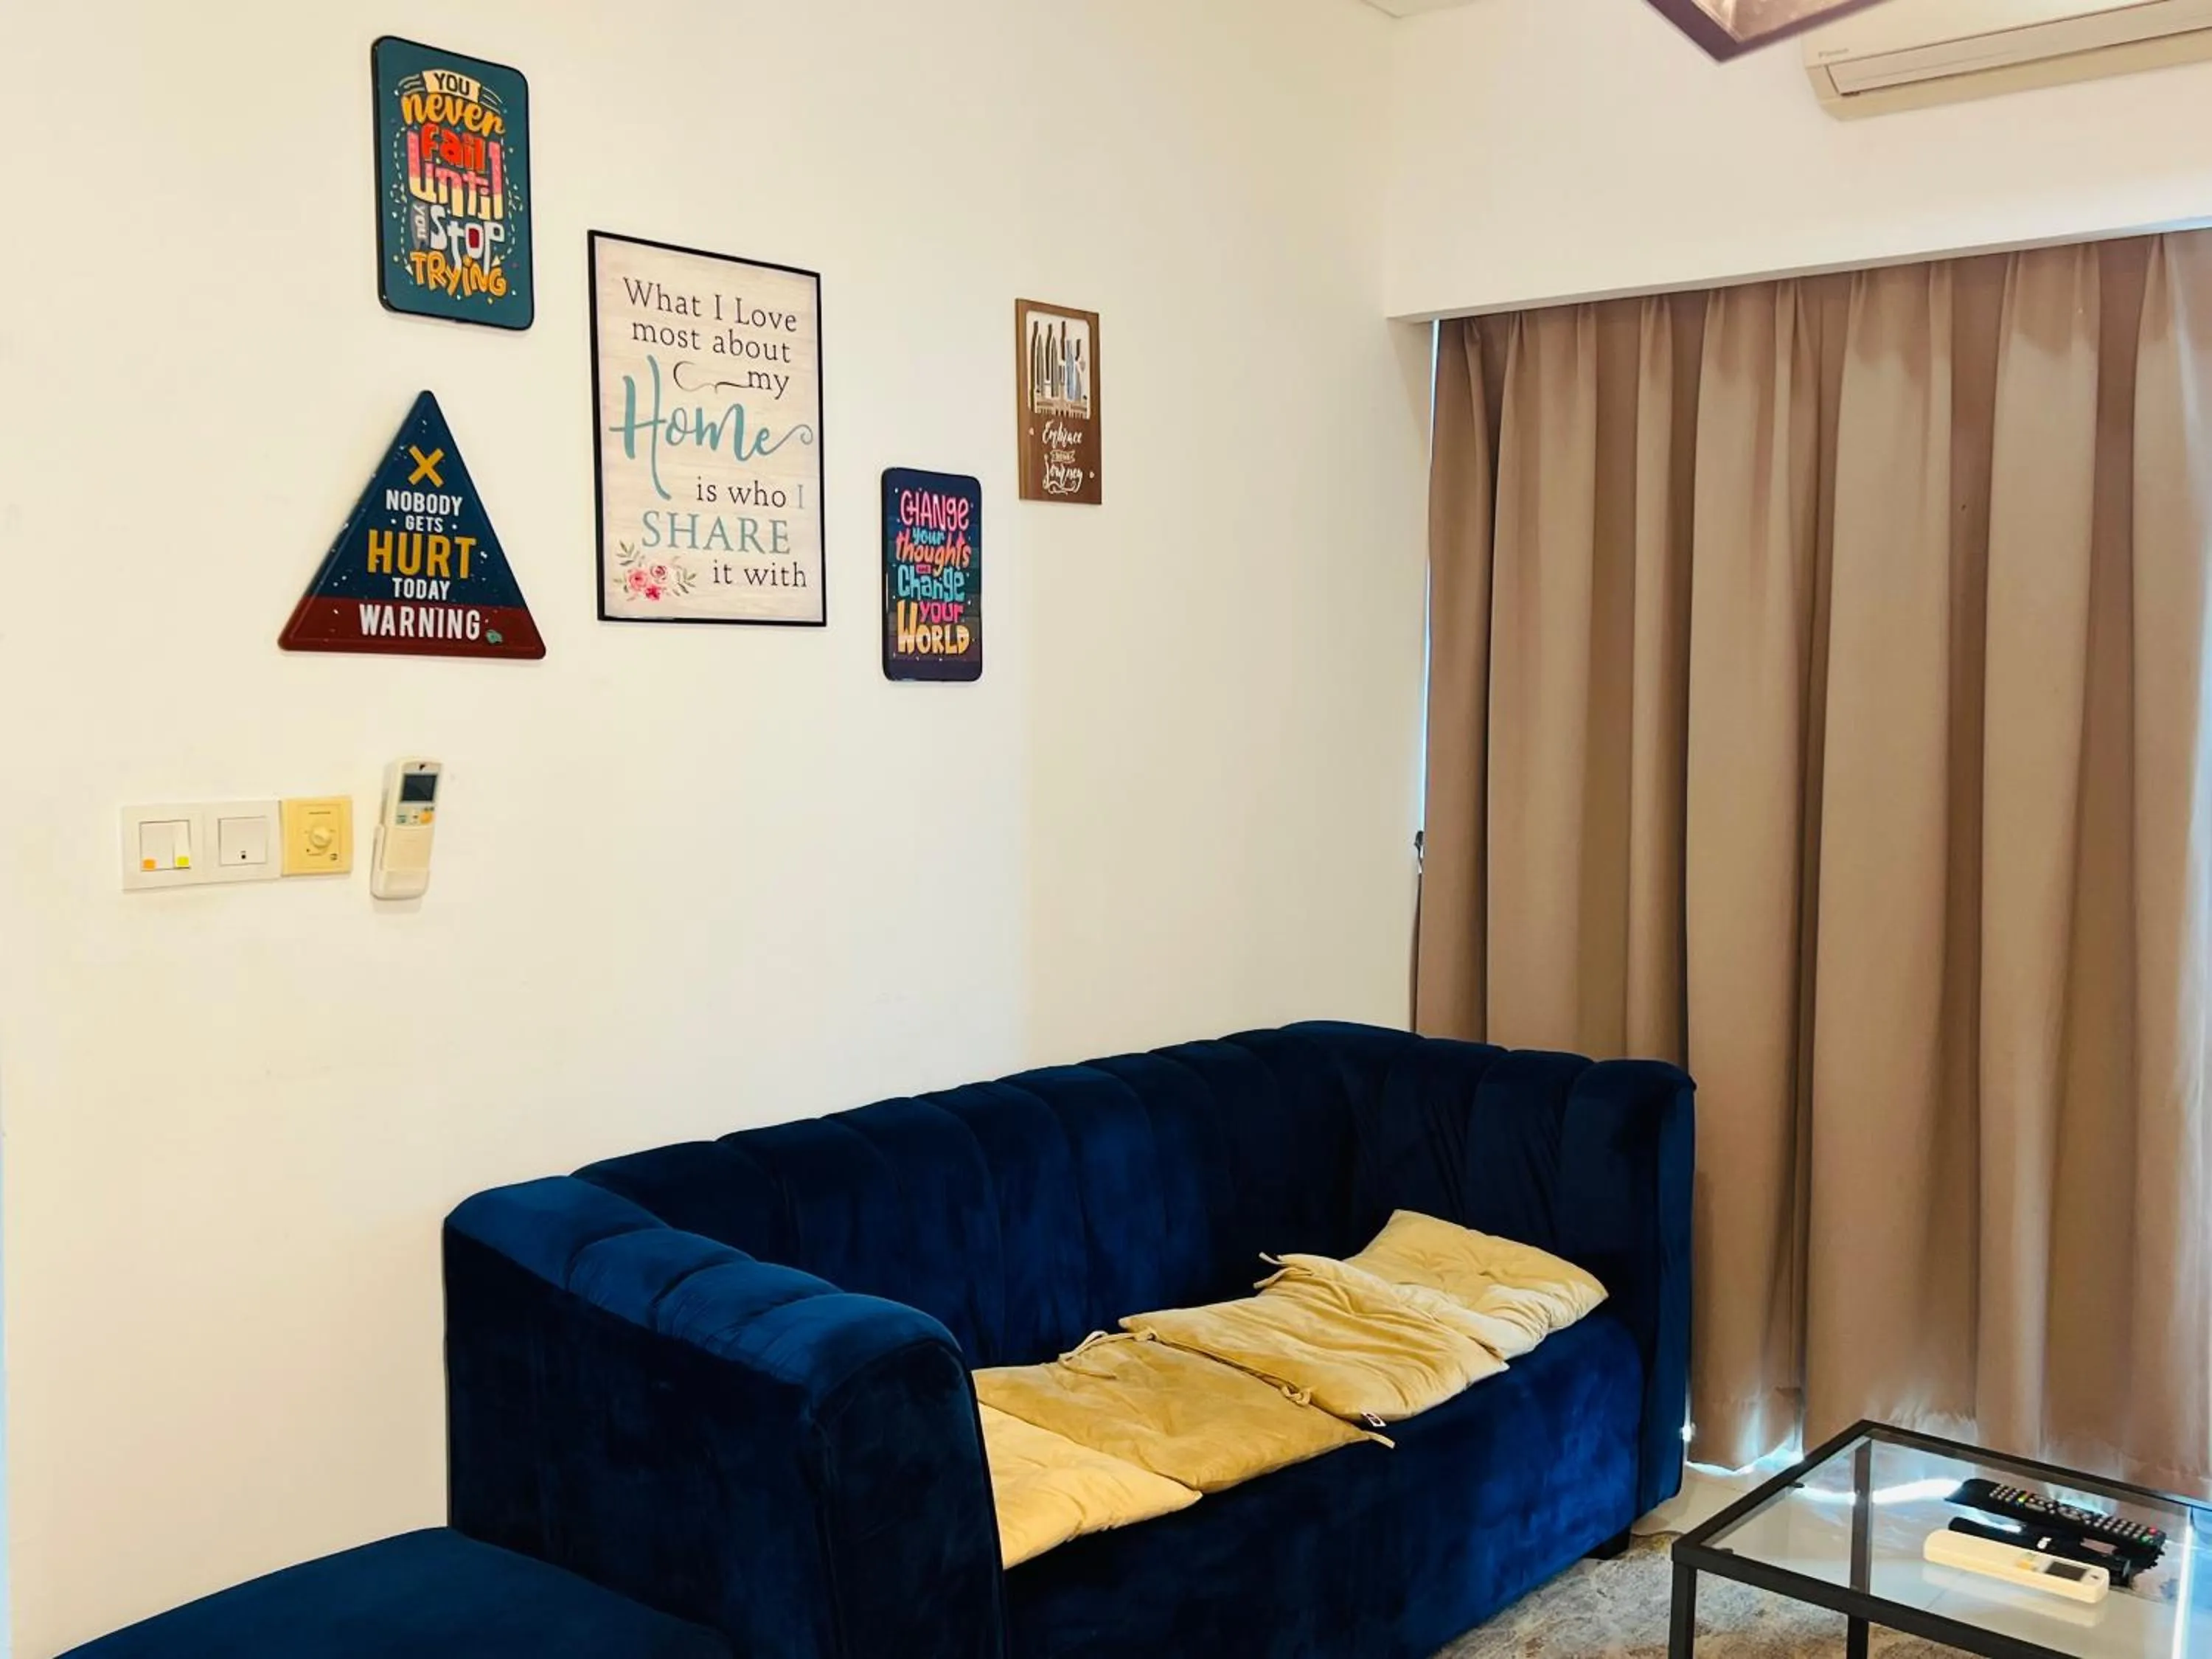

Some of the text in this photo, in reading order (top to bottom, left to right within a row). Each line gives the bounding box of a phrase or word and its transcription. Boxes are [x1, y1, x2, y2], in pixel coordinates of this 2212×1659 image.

[434, 72, 470, 97] YOU
[401, 94, 505, 136] never
[623, 277, 797, 332] What I Love
[632, 321, 790, 364] most about
[747, 370, 790, 400] my
[609, 355, 813, 501] Home
[386, 490, 463, 517] NOBODY
[697, 476, 805, 510] is who I
[406, 515, 444, 533] GETS
[641, 510, 790, 554] SHARE
[366, 529, 478, 579] HURT
[392, 577, 451, 601] TODAY
[713, 560, 807, 588] it with
[359, 603, 481, 641] WARNING
[897, 599, 970, 655] WORLD
